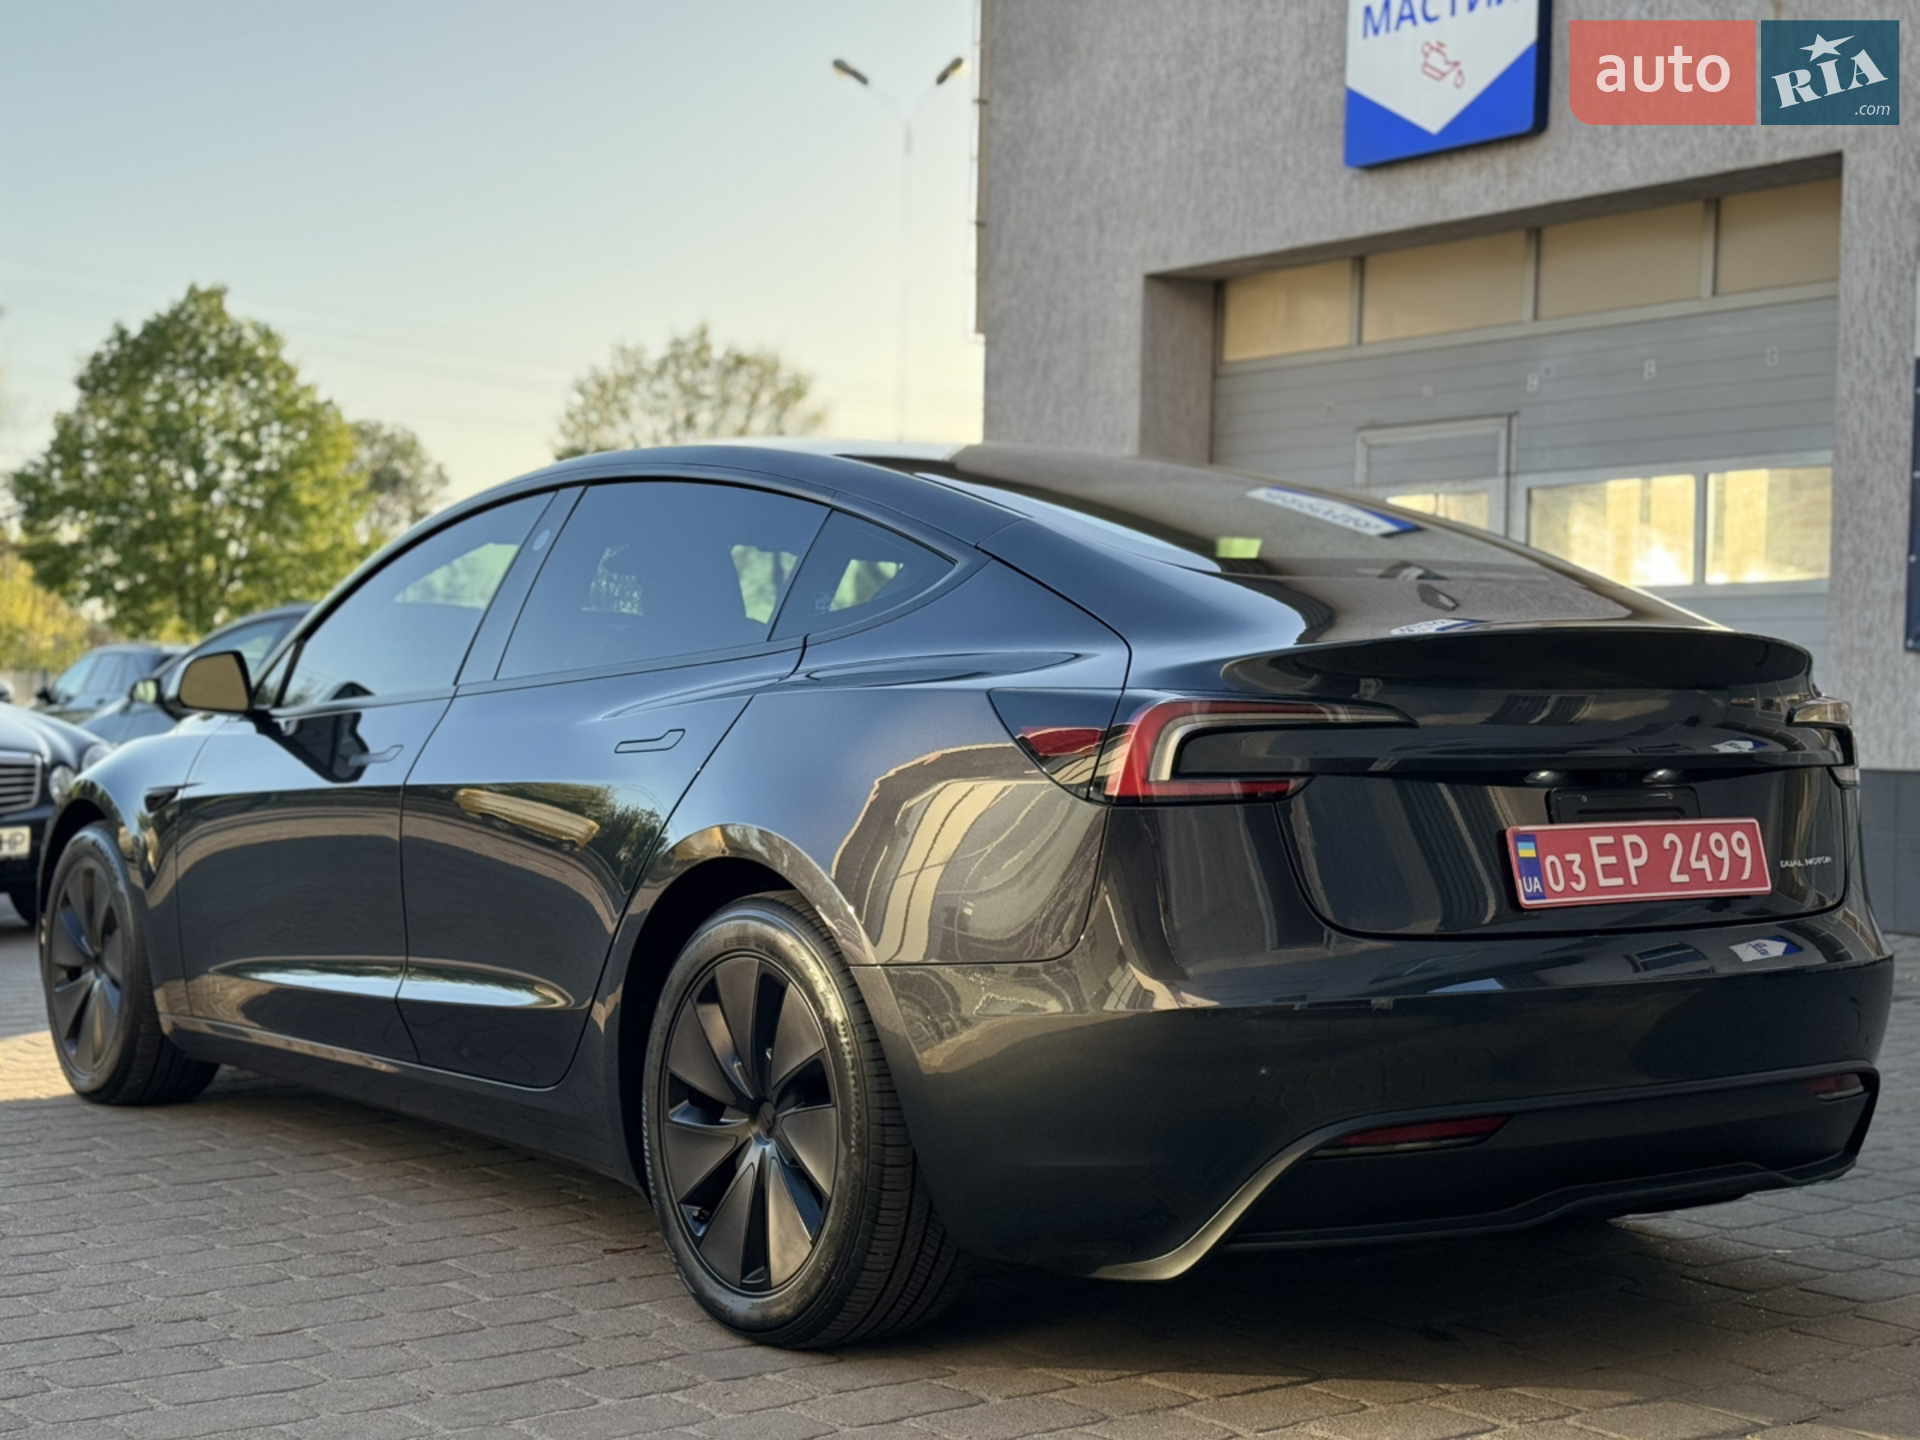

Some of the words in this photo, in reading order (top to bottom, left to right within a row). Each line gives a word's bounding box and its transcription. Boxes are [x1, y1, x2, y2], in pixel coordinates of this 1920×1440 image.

[1363, 0, 1519, 39] МАСТ
[1544, 853, 1588, 893] 03
[1589, 834, 1649, 887] EP
[1662, 830, 1752, 884] 2499
[1780, 859, 1804, 869] DUAL
[1804, 855, 1833, 867] MOTOR
[1522, 875, 1543, 894] UA
